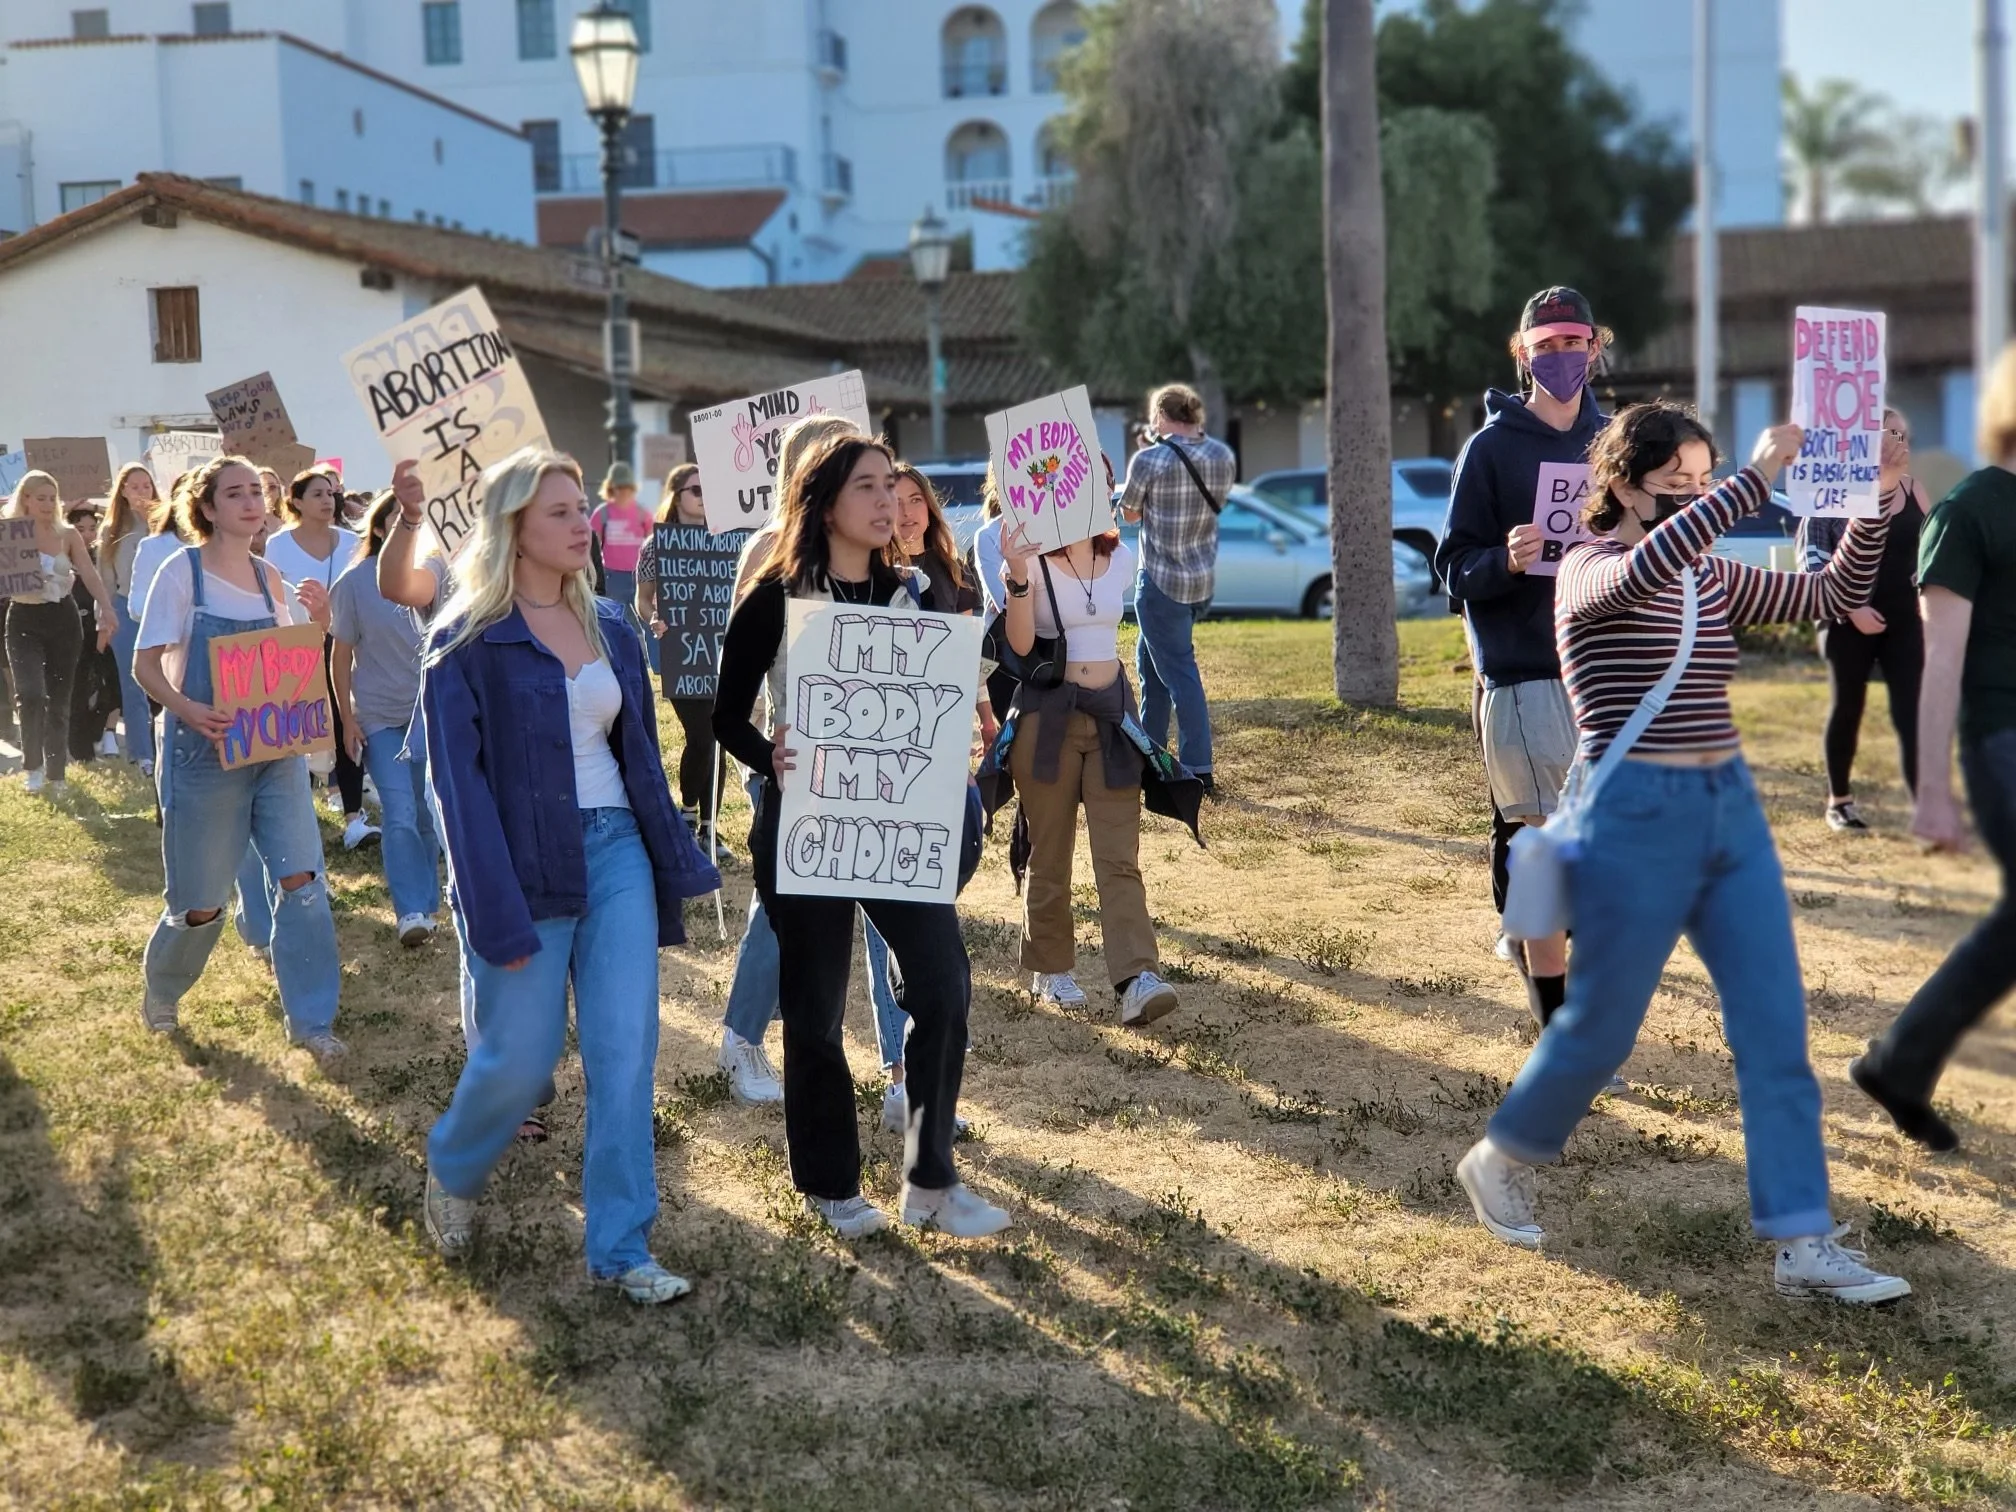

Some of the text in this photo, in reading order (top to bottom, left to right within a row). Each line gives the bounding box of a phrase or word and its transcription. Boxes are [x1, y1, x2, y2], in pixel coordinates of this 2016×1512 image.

[1795, 318, 1879, 361] DEFEND
[368, 328, 513, 432] ABORTION
[1813, 366, 1880, 431] ROE
[216, 398, 260, 423] LAWS
[748, 390, 800, 428] MIND
[152, 434, 222, 455] ABORTIO
[423, 406, 481, 462] IS
[1007, 421, 1080, 471] MY BODY
[461, 448, 482, 482] A
[1009, 444, 1090, 515] MY CHOICE
[1792, 463, 1807, 480] IS
[1814, 488, 1849, 510] CARE
[656, 527, 712, 552] MAKING
[658, 557, 736, 580] ILLEGAL DOE
[663, 582, 696, 601] STOP
[668, 606, 688, 627] IT
[828, 613, 952, 678] MY
[217, 636, 321, 703] MY BODY
[675, 675, 719, 696] ABORT
[223, 697, 328, 765] MY CHOICE
[796, 674, 964, 749] BODY
[810, 744, 932, 804] MY
[785, 815, 949, 889] CHOICE
